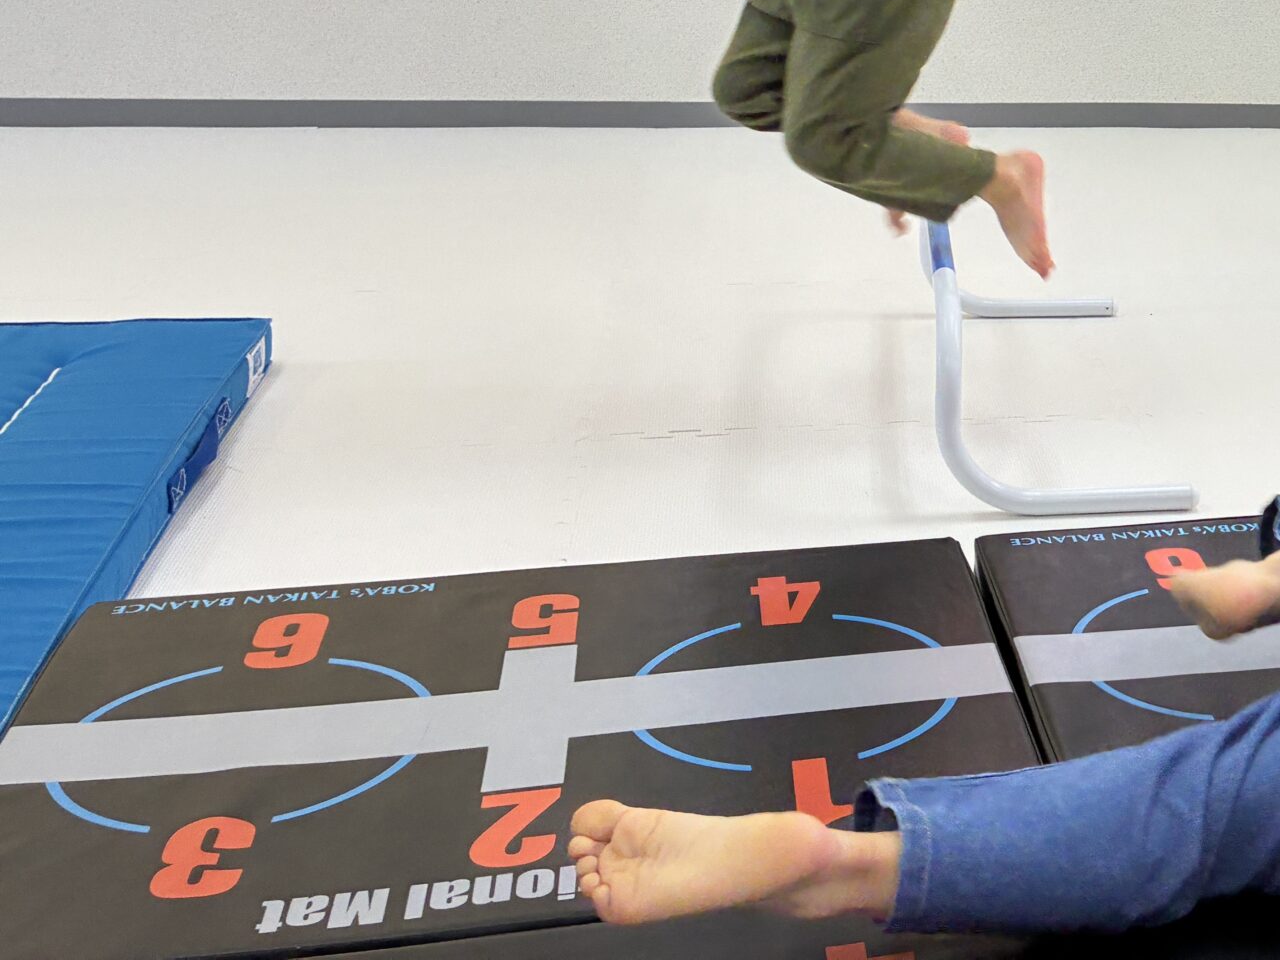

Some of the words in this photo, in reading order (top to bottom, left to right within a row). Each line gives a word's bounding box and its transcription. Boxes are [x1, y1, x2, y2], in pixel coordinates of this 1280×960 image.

[1010, 531, 1106, 547] BALANCE
[1112, 526, 1190, 541] TAIKAN
[243, 589, 341, 606] TAIKAN
[349, 582, 438, 597] KOBA's
[749, 575, 821, 627] 4
[111, 597, 236, 616] BALANCE
[507, 593, 581, 650] 5
[468, 786, 563, 869] 2
[148, 815, 257, 900] 3
[254, 887, 391, 935] Mat
